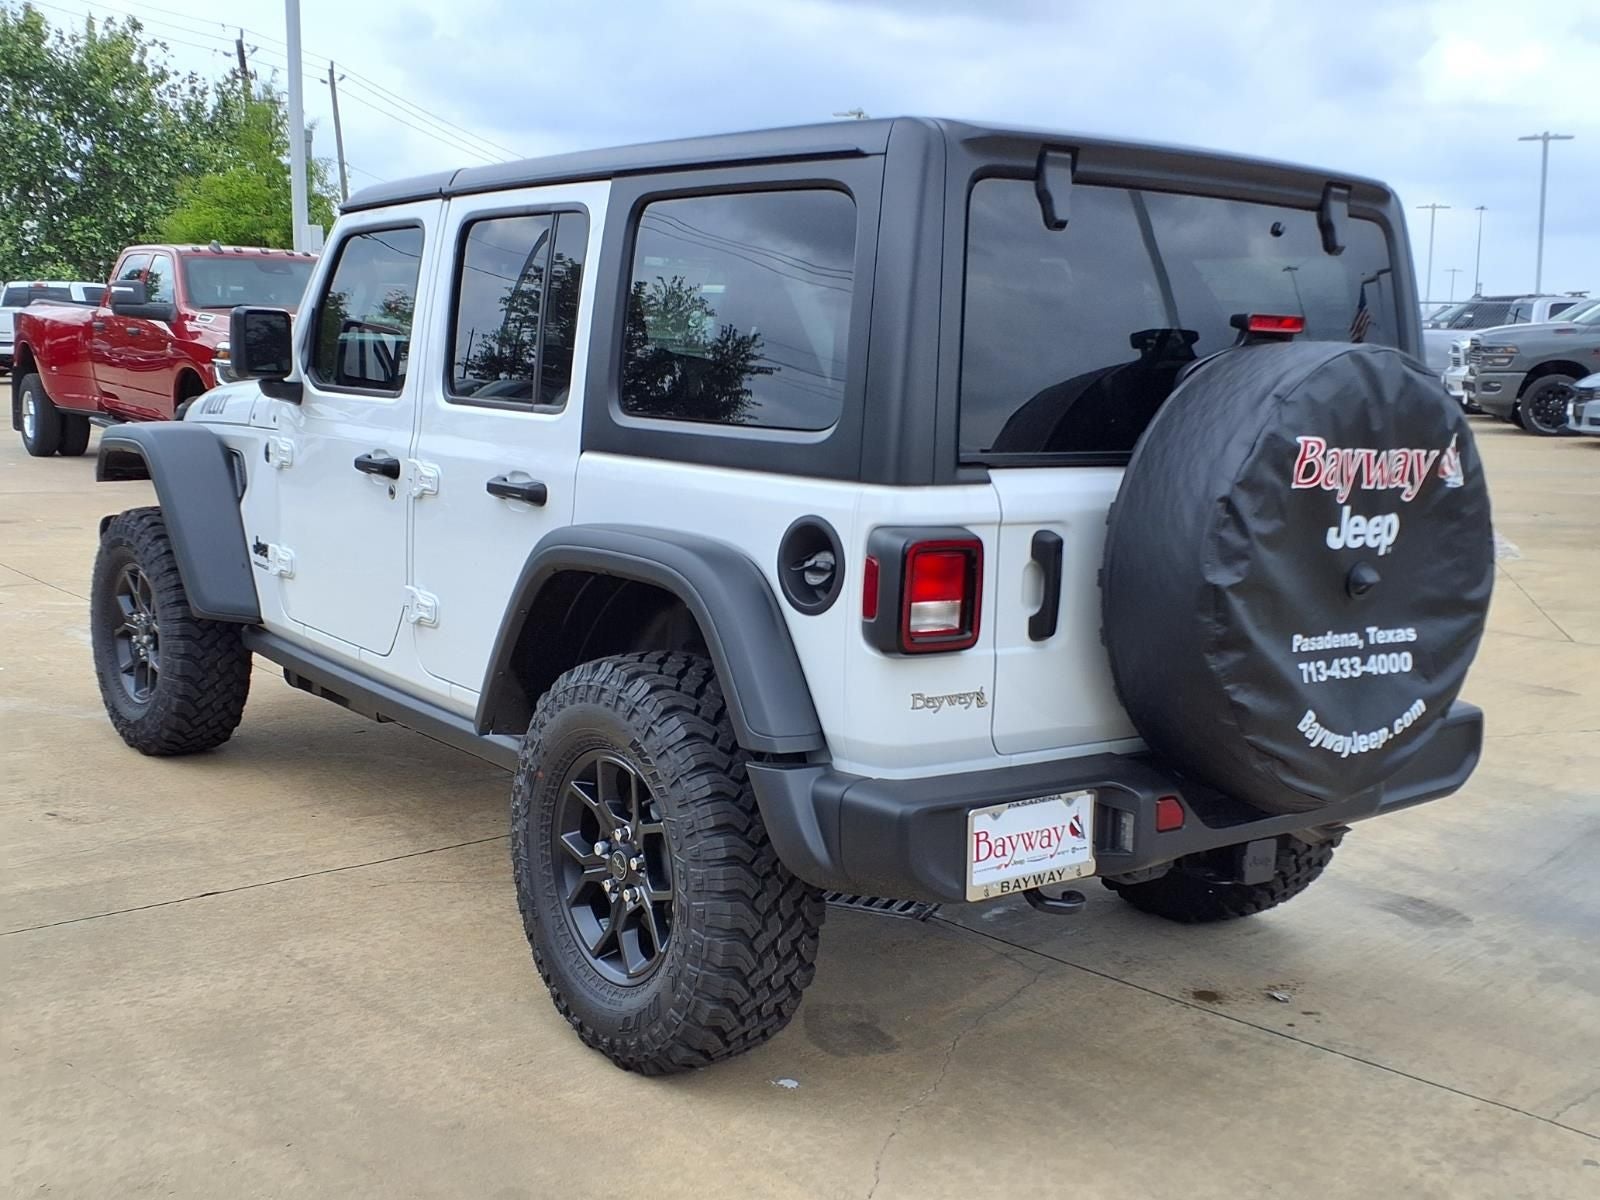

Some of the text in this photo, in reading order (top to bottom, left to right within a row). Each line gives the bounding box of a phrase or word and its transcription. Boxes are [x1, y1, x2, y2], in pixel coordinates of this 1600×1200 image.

[1291, 435, 1440, 503] Bayway
[1326, 505, 1399, 556] Jeep
[1292, 626, 1418, 653] Pasadena, Texas
[1298, 651, 1413, 684] 713-433-4000
[910, 691, 978, 714] Bayway
[1297, 698, 1427, 759] BaywayJeep.com
[973, 825, 1066, 868] Bayway
[1000, 868, 1066, 893] BAYWAY
